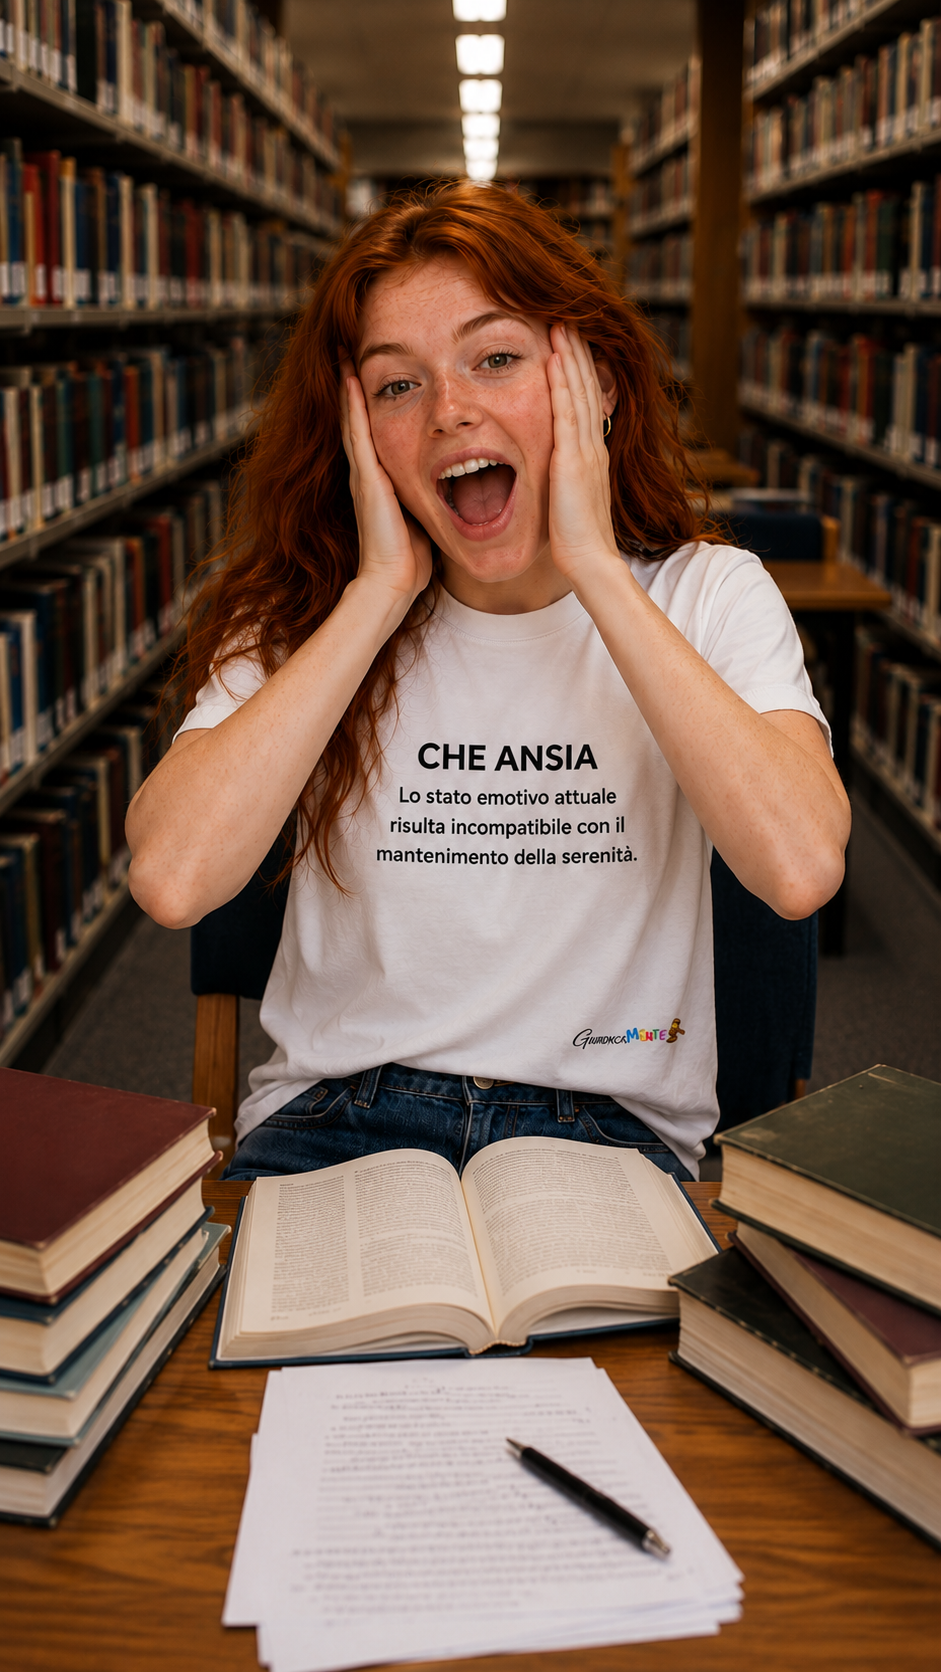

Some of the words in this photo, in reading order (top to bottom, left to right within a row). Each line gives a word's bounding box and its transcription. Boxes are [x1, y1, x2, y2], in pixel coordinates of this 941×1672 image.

[417, 742, 487, 771] CHE
[494, 743, 599, 772] ANSIA
[398, 786, 421, 804] Lo
[426, 788, 472, 806] stato
[477, 788, 550, 806] emotivo
[554, 787, 618, 805] attuale
[390, 816, 445, 834] risulta
[451, 818, 572, 840] incompatibile
[577, 820, 610, 834] con
[615, 816, 625, 833] il
[376, 847, 509, 865] mantenimento
[513, 848, 556, 865] della
[561, 845, 638, 865] serenità.
